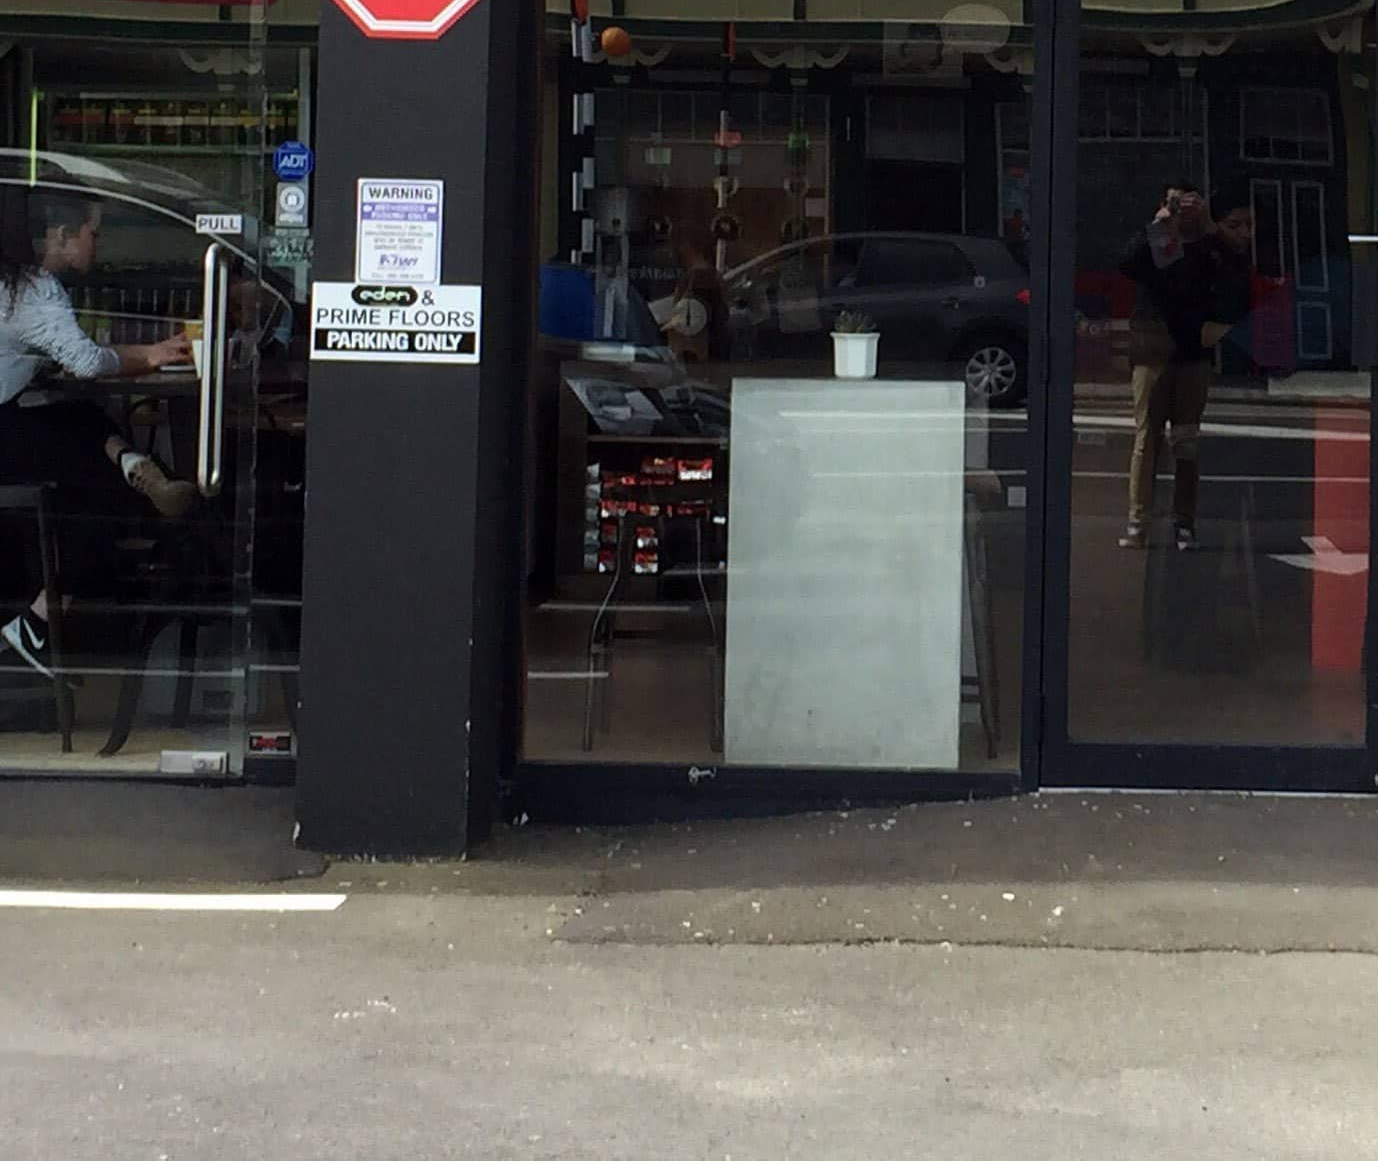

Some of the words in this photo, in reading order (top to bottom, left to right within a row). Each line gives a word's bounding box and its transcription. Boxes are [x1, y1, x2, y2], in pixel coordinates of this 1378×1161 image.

[279, 154, 306, 168] ADT
[368, 186, 433, 200] WARNING
[198, 217, 239, 230] PULL
[359, 285, 411, 302] eden
[421, 289, 435, 306] &
[316, 308, 381, 326] PRIME
[388, 309, 475, 327] FLOORS
[326, 330, 409, 351] PARKING
[414, 332, 462, 352] ONLY
